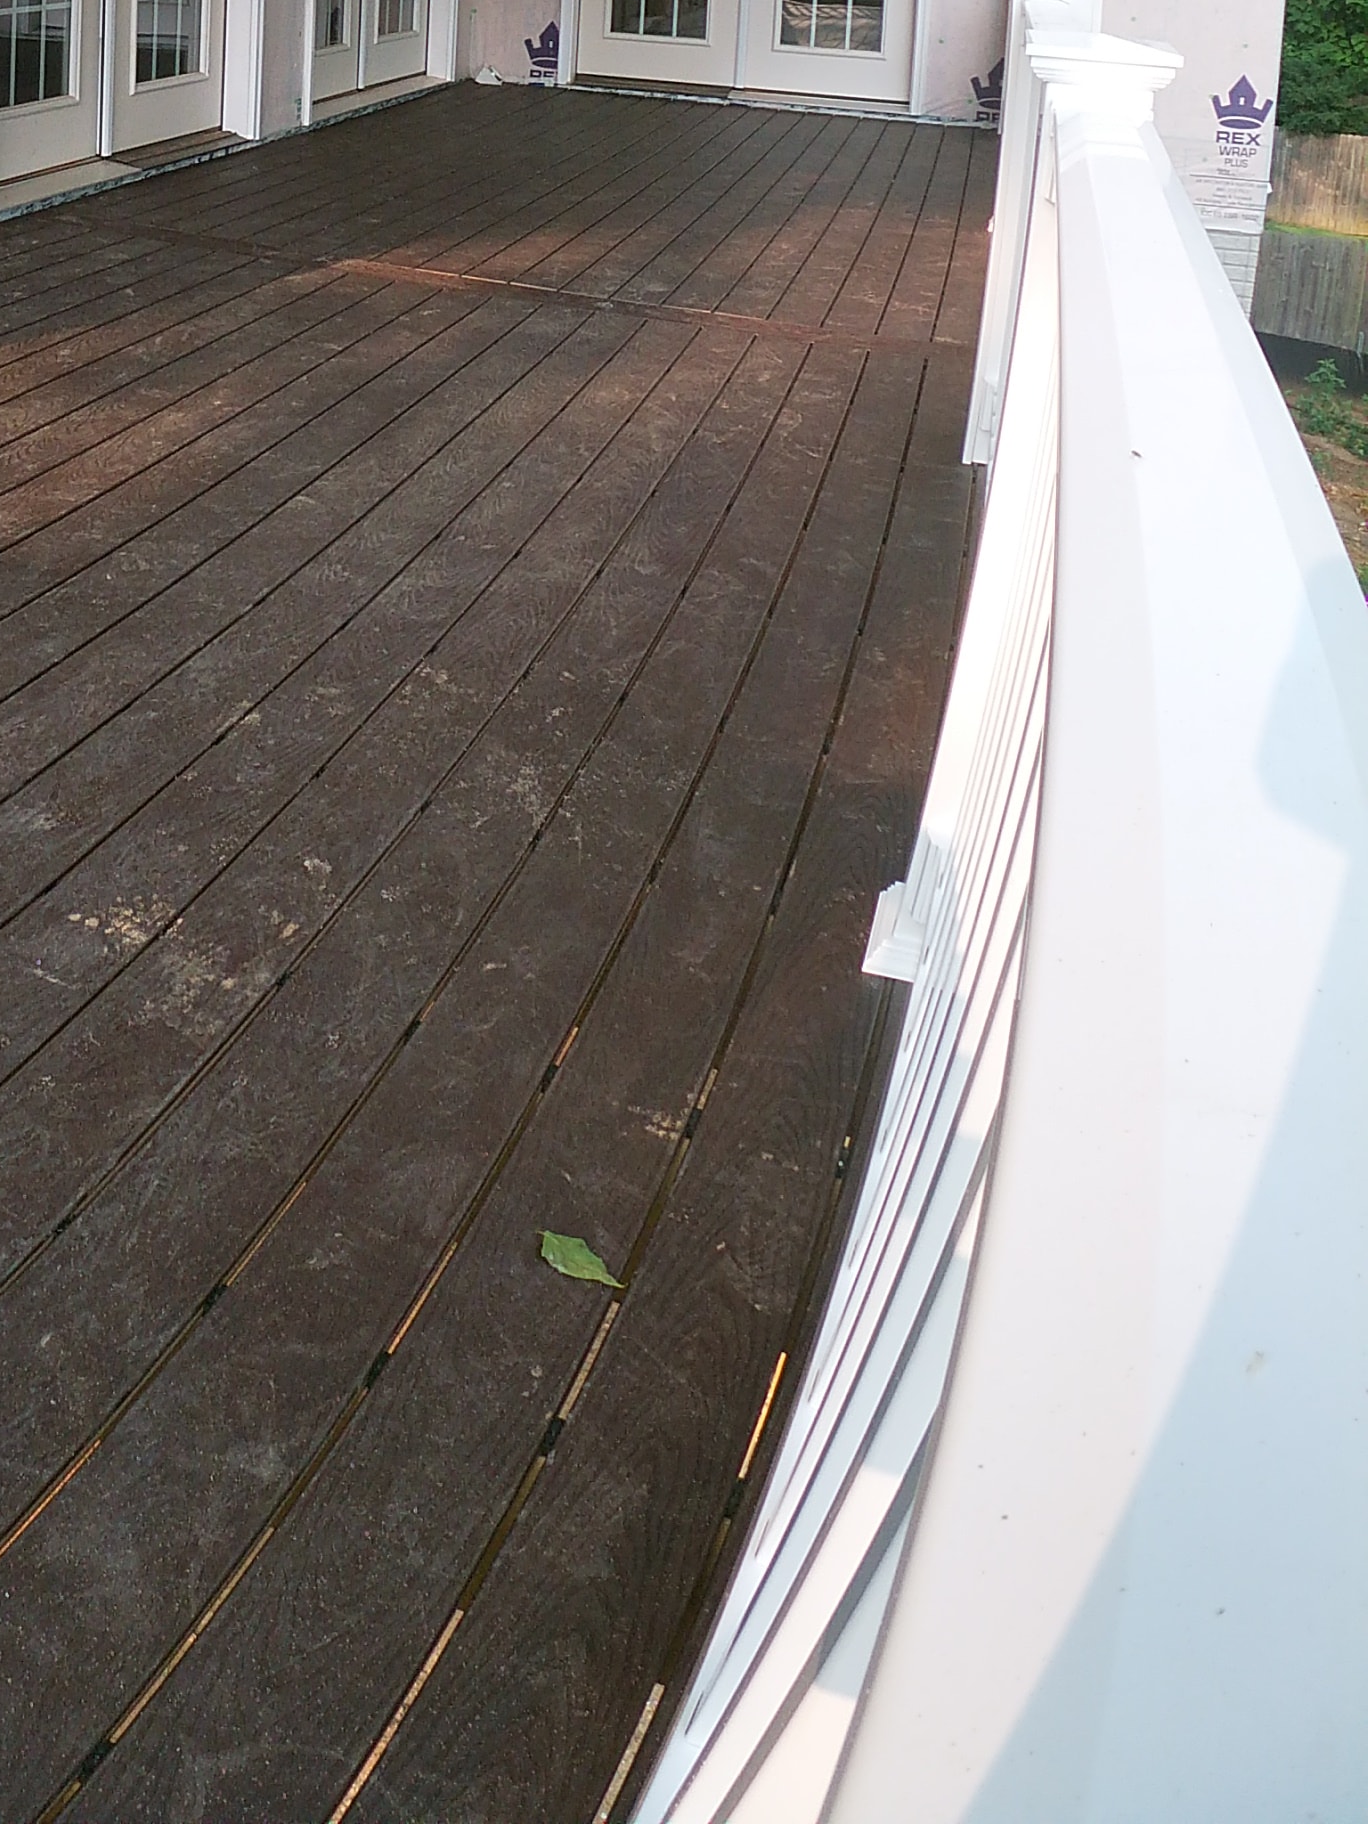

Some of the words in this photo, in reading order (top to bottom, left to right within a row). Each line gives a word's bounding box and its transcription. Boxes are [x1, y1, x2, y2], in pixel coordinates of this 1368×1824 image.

[1215, 130, 1261, 146] REX
[1219, 146, 1257, 158] WRAP
[1224, 157, 1248, 168] PLUS
